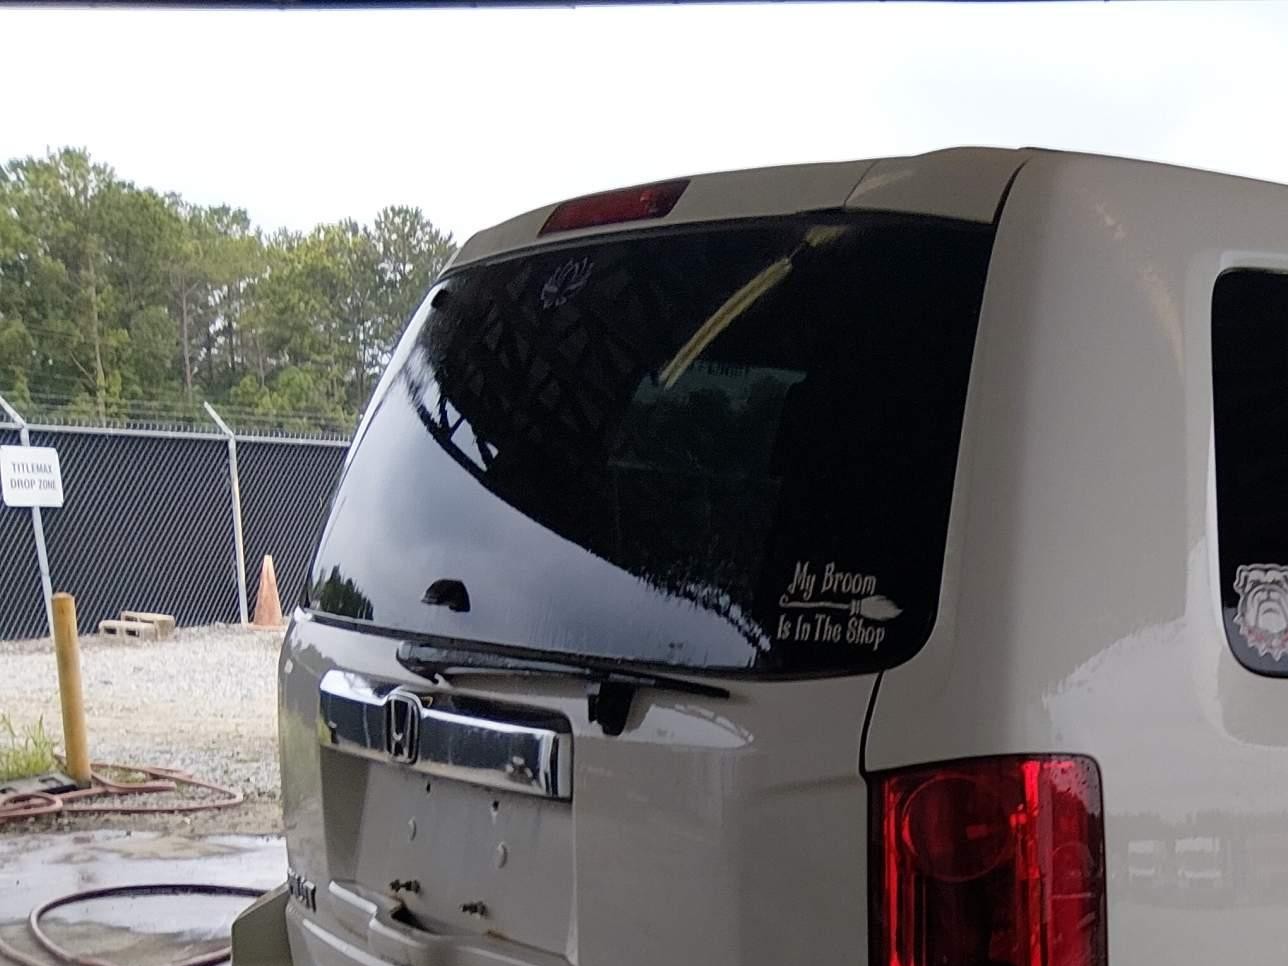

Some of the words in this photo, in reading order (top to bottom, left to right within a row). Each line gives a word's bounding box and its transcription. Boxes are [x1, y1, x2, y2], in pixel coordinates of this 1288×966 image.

[11, 462, 53, 473] TITLEMAX
[10, 479, 36, 489] DROP
[38, 479, 56, 489] ZONE
[787, 561, 816, 601] My
[821, 561, 877, 595] Broom
[777, 613, 792, 640] Is
[794, 614, 811, 641] In
[814, 613, 842, 643] The
[846, 617, 886, 651] Shop
